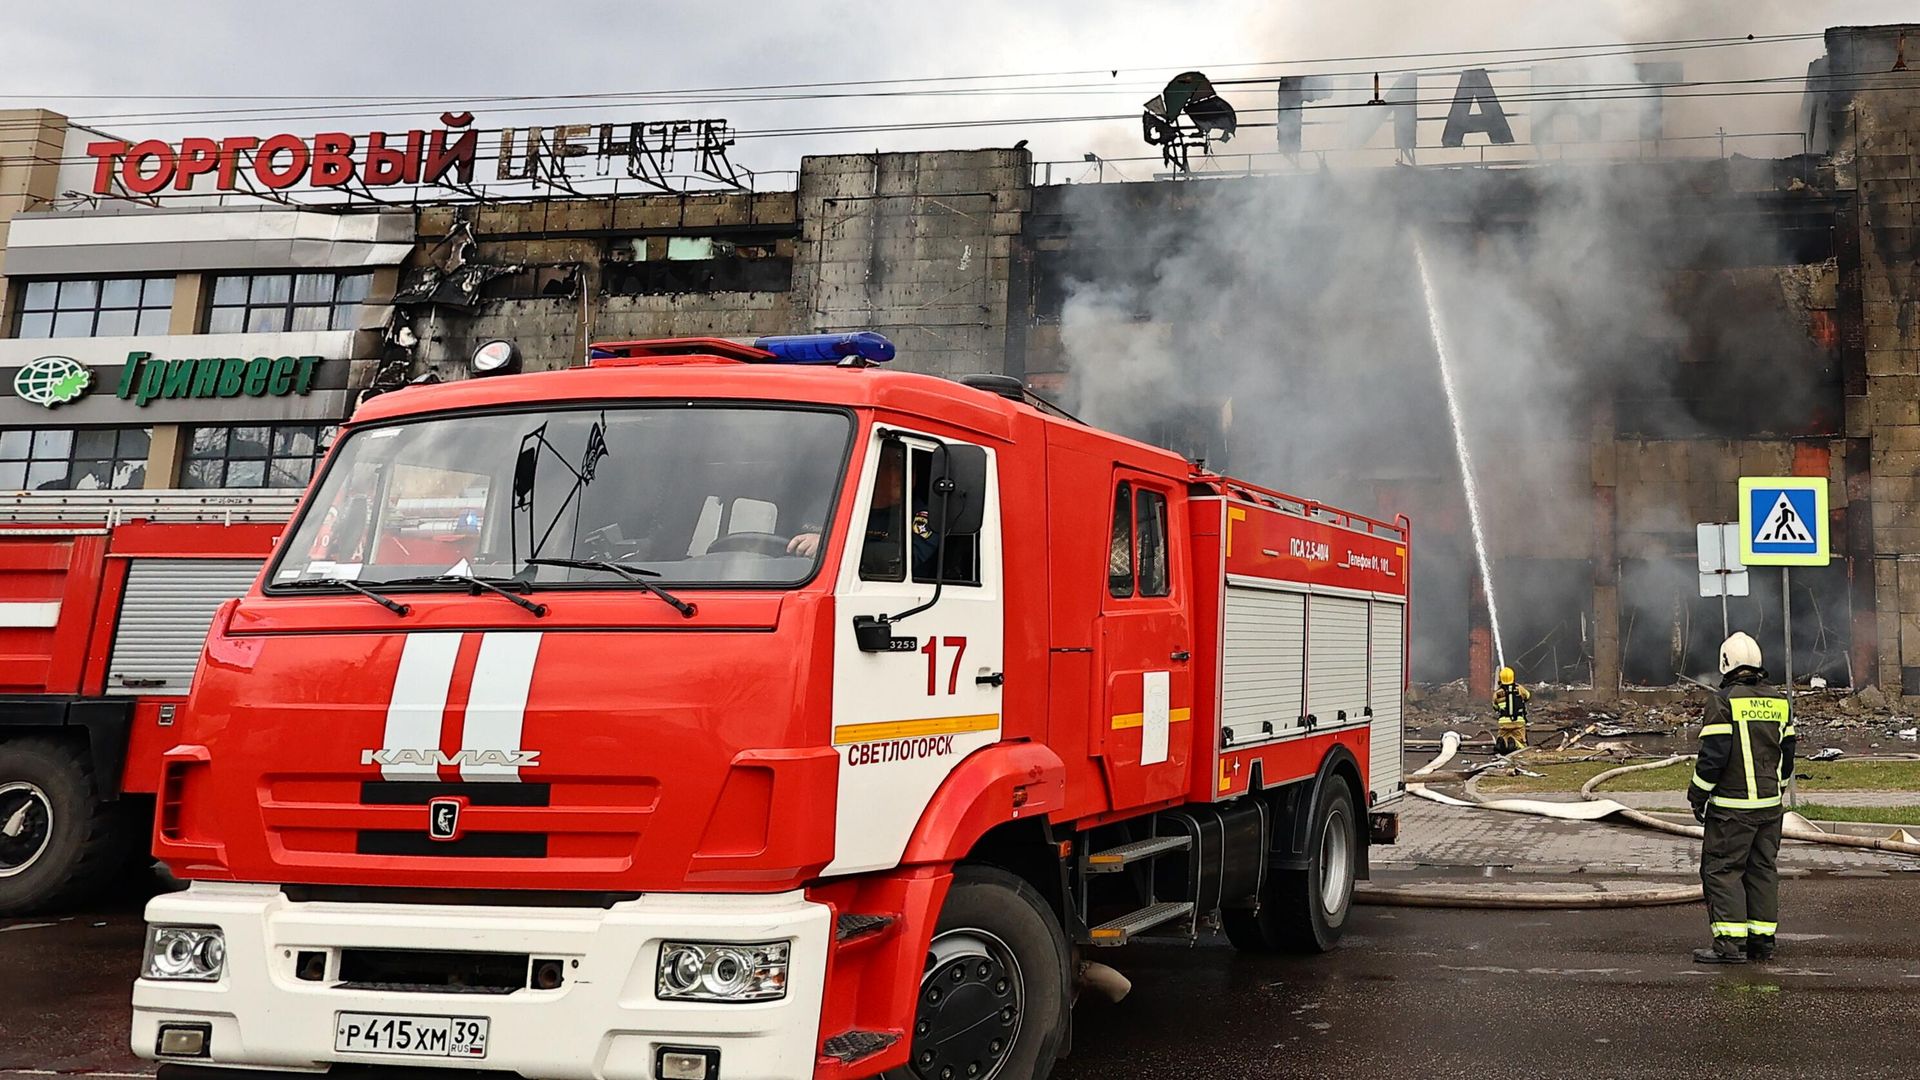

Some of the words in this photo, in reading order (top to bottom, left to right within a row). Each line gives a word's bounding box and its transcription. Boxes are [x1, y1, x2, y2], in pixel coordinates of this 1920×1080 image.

[86, 112, 478, 195] ТОРГОВЫЙ
[117, 351, 323, 407] Гринвест
[1290, 537, 1306, 557] ПСА
[1305, 540, 1329, 562] 2,5-40/4
[1347, 550, 1372, 571] Телефон
[889, 640, 916, 649] 3253
[921, 636, 967, 696] 17
[1741, 710, 1783, 720] РОССИИ
[1750, 699, 1773, 709] МЧС
[360, 749, 541, 767] KAMAZ
[847, 735, 954, 767] СВЕТЛОГОРСК
[454, 1021, 480, 1045] 39
[450, 1043, 470, 1053] RUS
